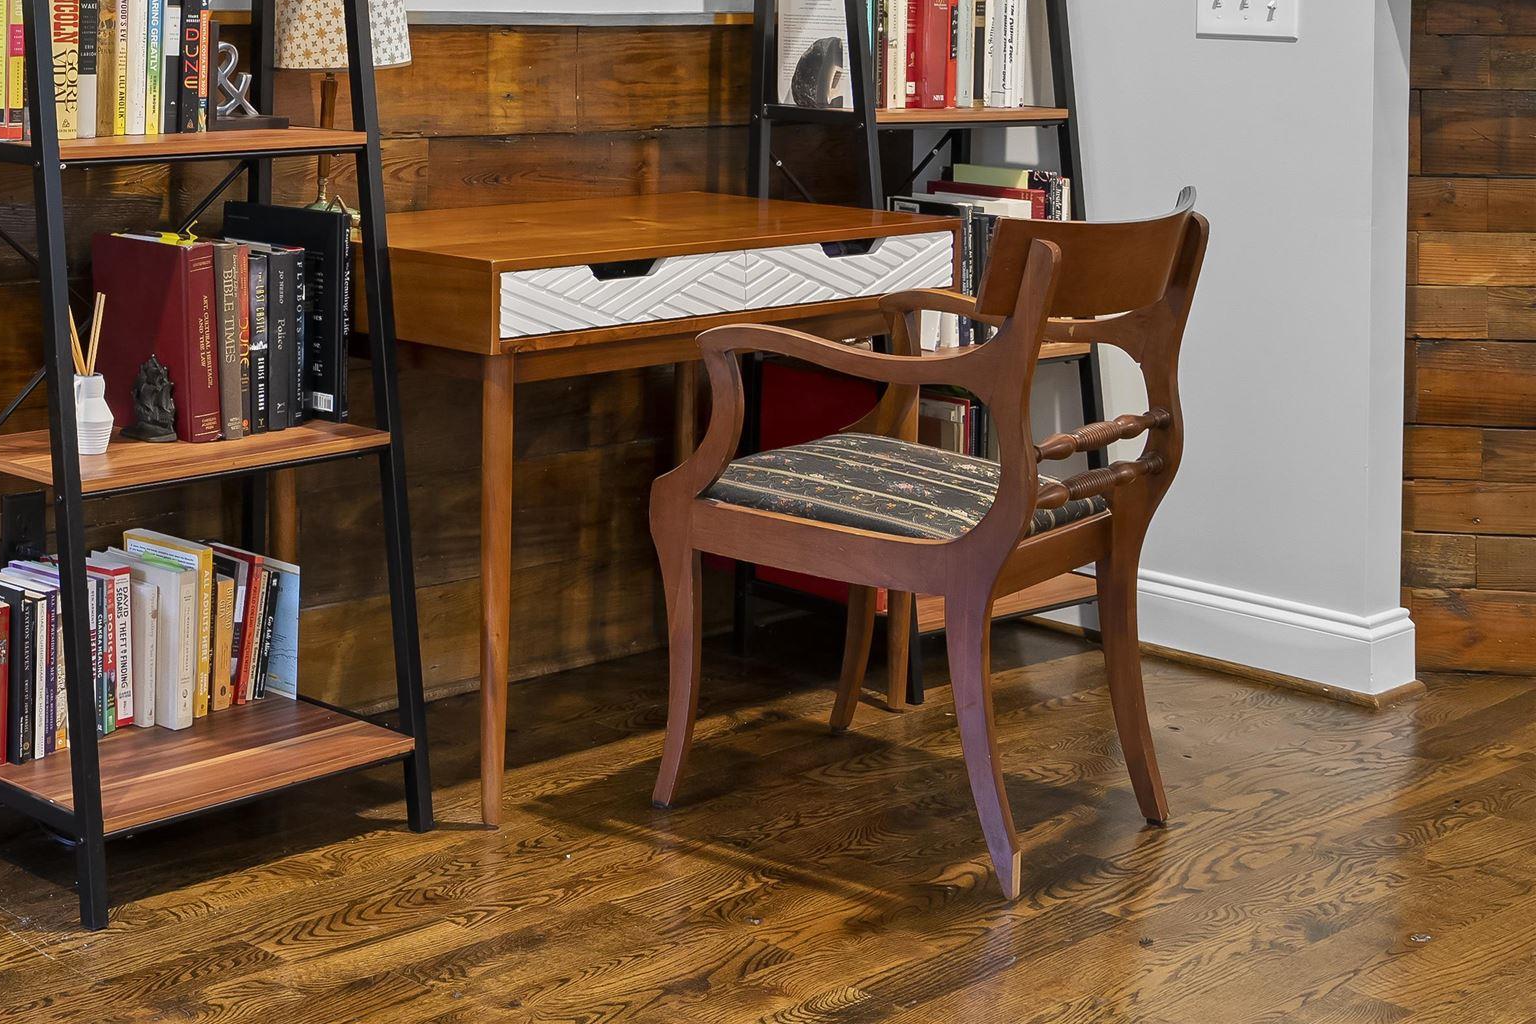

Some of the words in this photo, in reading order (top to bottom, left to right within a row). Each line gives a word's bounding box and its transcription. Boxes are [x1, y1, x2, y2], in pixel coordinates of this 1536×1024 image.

[120, 29, 128, 42] EVE
[150, 28, 159, 71] GREATLY
[65, 49, 78, 113] GORE
[223, 269, 235, 312] BIBLE
[256, 285, 265, 302] LAST
[343, 270, 351, 311] Meaning
[256, 307, 265, 334] CASTLE
[277, 319, 286, 350] Police
[224, 315, 236, 364] TIMES
[202, 592, 210, 632] ADULTS
[267, 616, 274, 626] Go
[119, 621, 128, 647] THEFT
[120, 656, 128, 689] FINDING
